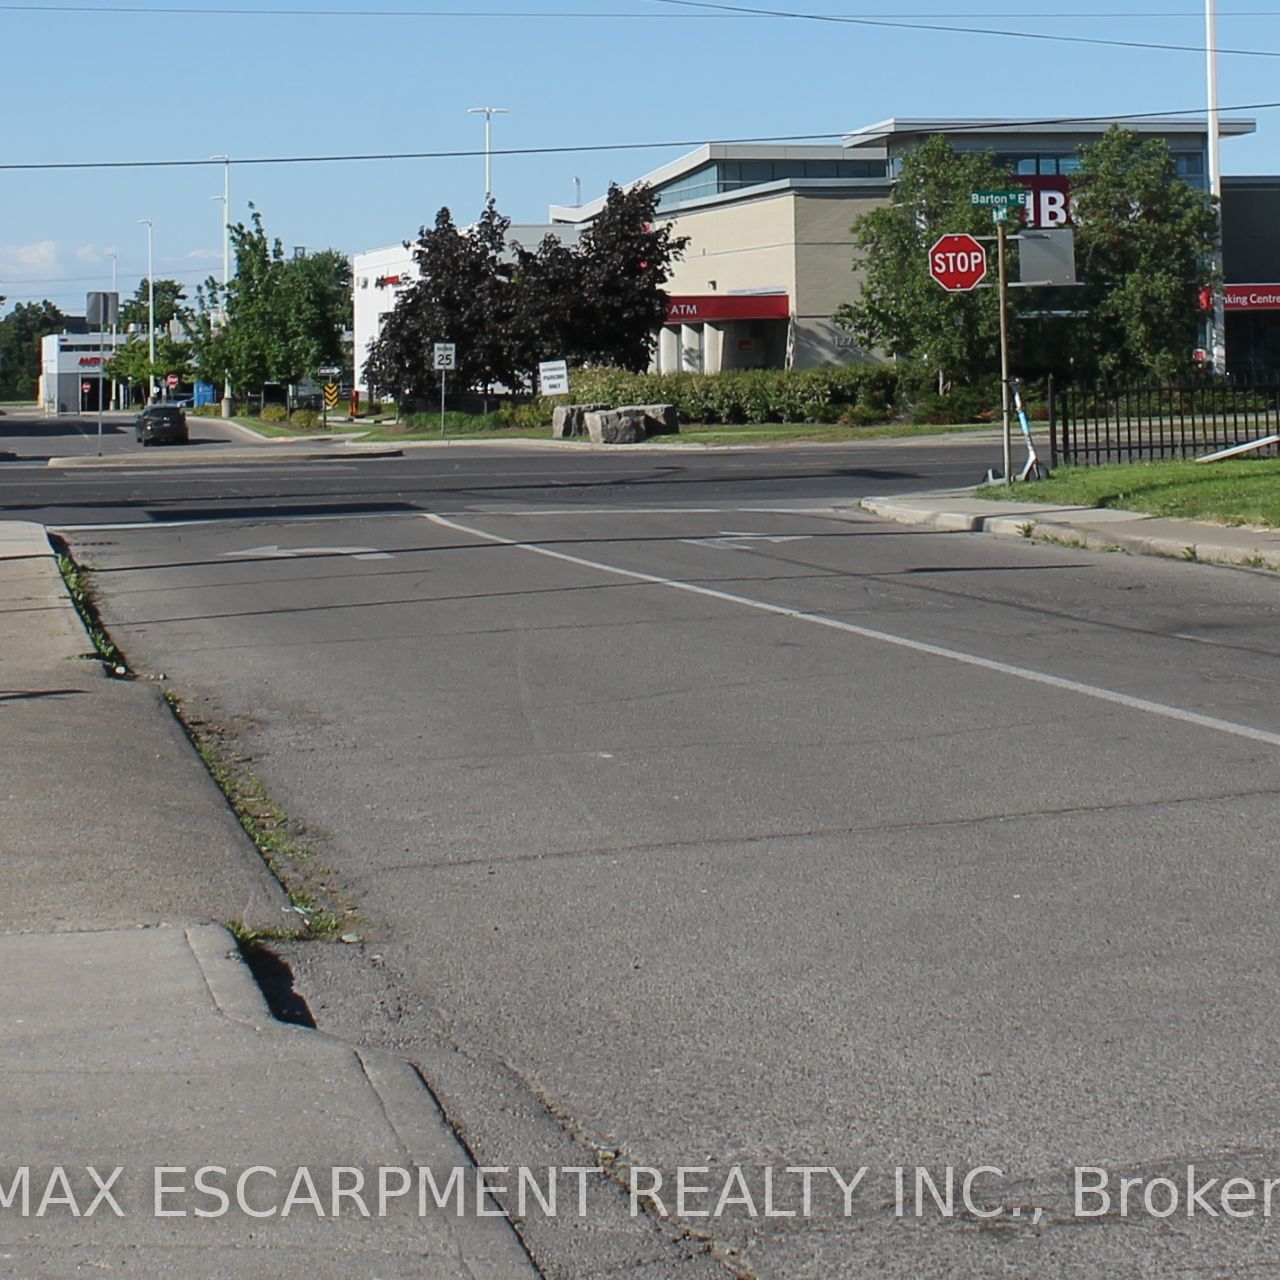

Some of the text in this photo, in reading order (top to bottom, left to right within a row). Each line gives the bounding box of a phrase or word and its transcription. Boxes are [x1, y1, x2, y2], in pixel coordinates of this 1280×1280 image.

[971, 193, 1008, 205] Barton
[1018, 193, 1027, 204] E
[934, 251, 982, 273] STOP
[670, 304, 697, 315] ATM
[437, 353, 453, 366] 25
